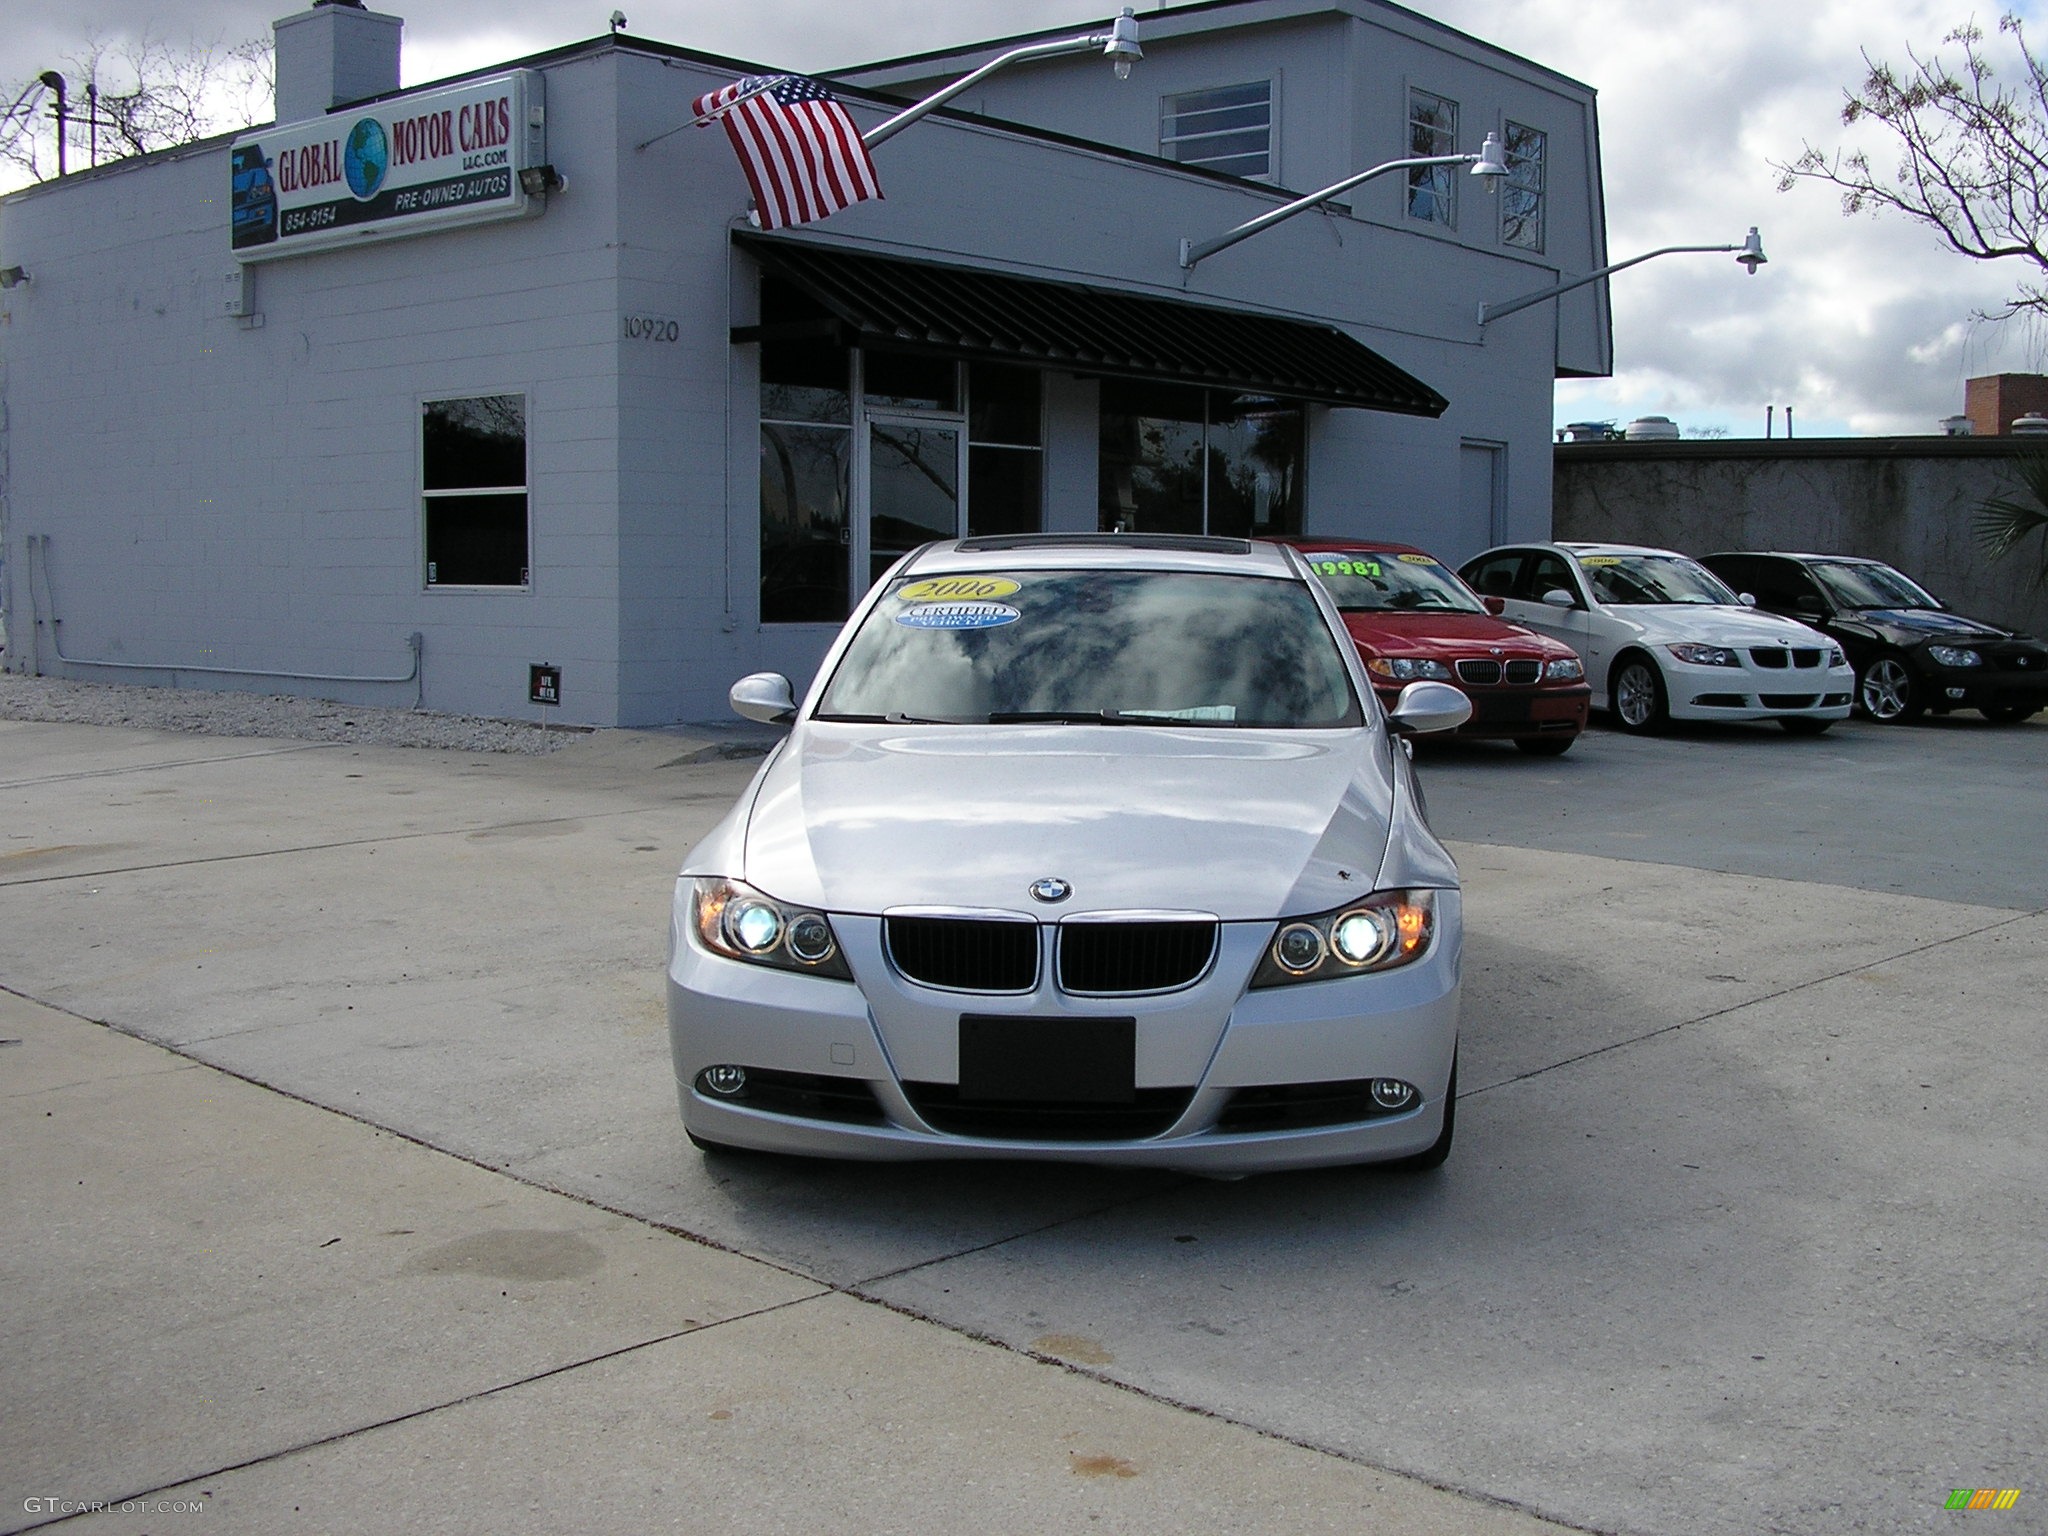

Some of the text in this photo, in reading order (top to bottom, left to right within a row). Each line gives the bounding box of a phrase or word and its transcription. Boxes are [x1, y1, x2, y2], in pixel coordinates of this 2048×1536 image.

[278, 96, 509, 193] GLOBAL MOTOR CARS
[463, 149, 507, 170] LLC.COM
[395, 174, 508, 212] PRE-OWNED AUTOS
[285, 205, 337, 231] 854-9154
[623, 316, 679, 342] 10920
[1311, 561, 1380, 576] 19987
[912, 580, 998, 597] 2006
[909, 606, 1007, 616] CERTIFIED
